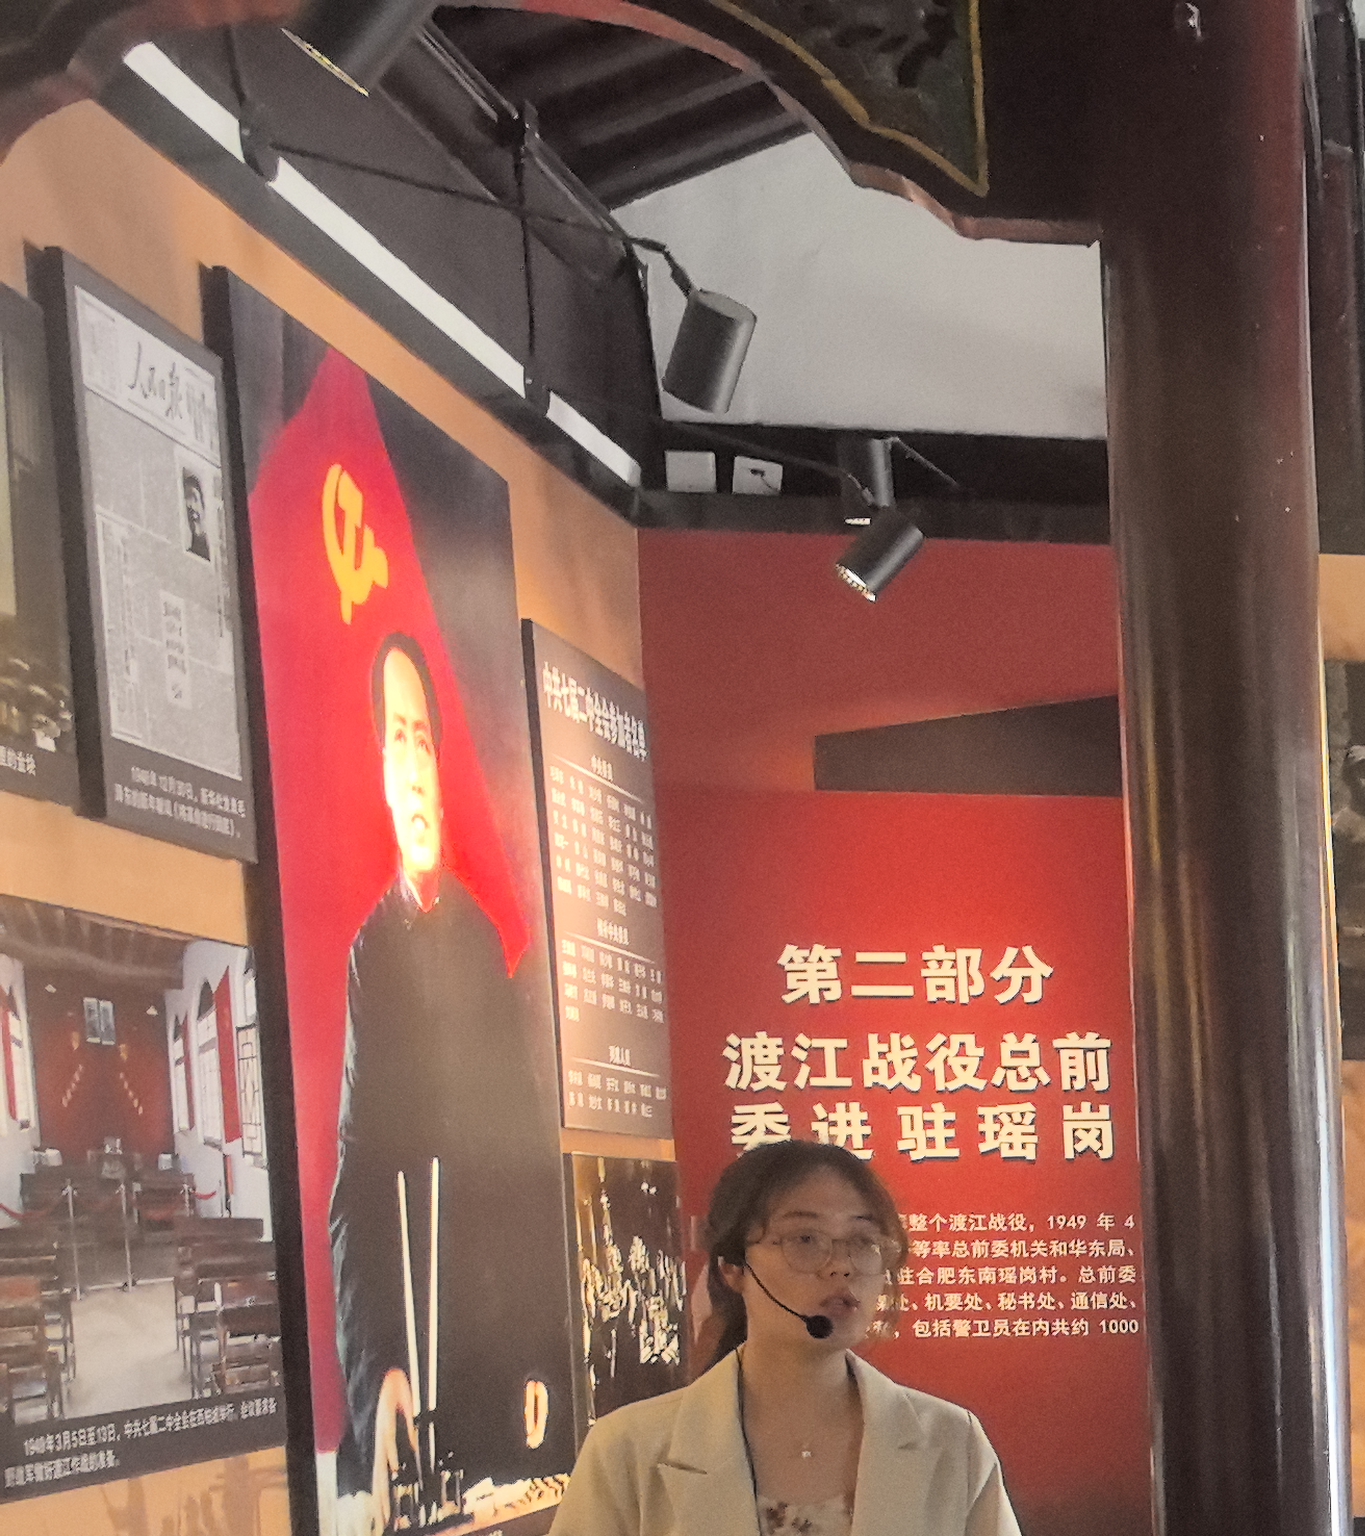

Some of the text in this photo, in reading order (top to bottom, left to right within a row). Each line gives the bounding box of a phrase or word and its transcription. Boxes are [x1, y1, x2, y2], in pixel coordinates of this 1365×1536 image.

[777, 942, 1055, 1005] 第二部分
[721, 1030, 1113, 1095] 渡江战役总前
[730, 1101, 1117, 1162] 委进驻瑶岗
